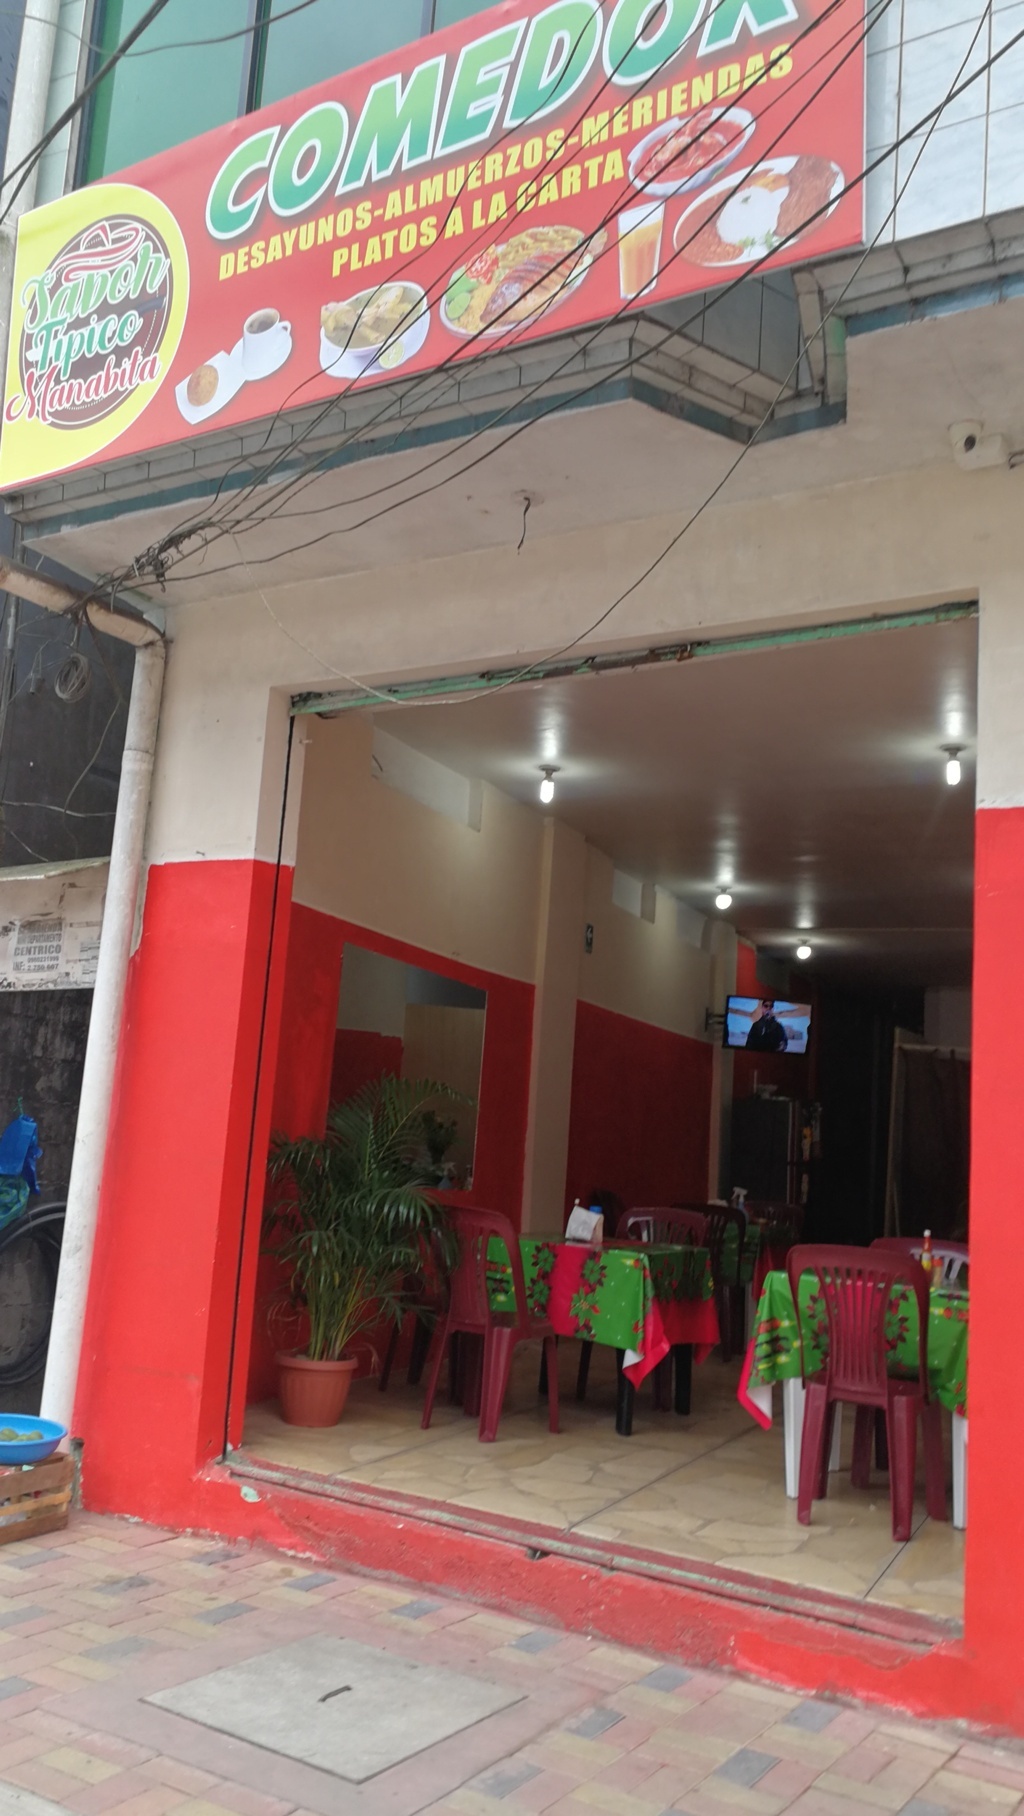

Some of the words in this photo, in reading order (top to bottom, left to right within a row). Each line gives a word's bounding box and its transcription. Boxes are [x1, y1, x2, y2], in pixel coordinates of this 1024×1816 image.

[219, 43, 793, 281] DESAYUNOS-ALMUERZOS-MERIENDAS
[332, 215, 438, 278] PLATOS
[444, 207, 464, 246] A
[472, 191, 507, 229] LA
[516, 148, 625, 213] CARTA
[21, 241, 170, 334] Sabor
[4, 347, 160, 424] Manabita
[14, 944, 62, 957] CENTRICO
